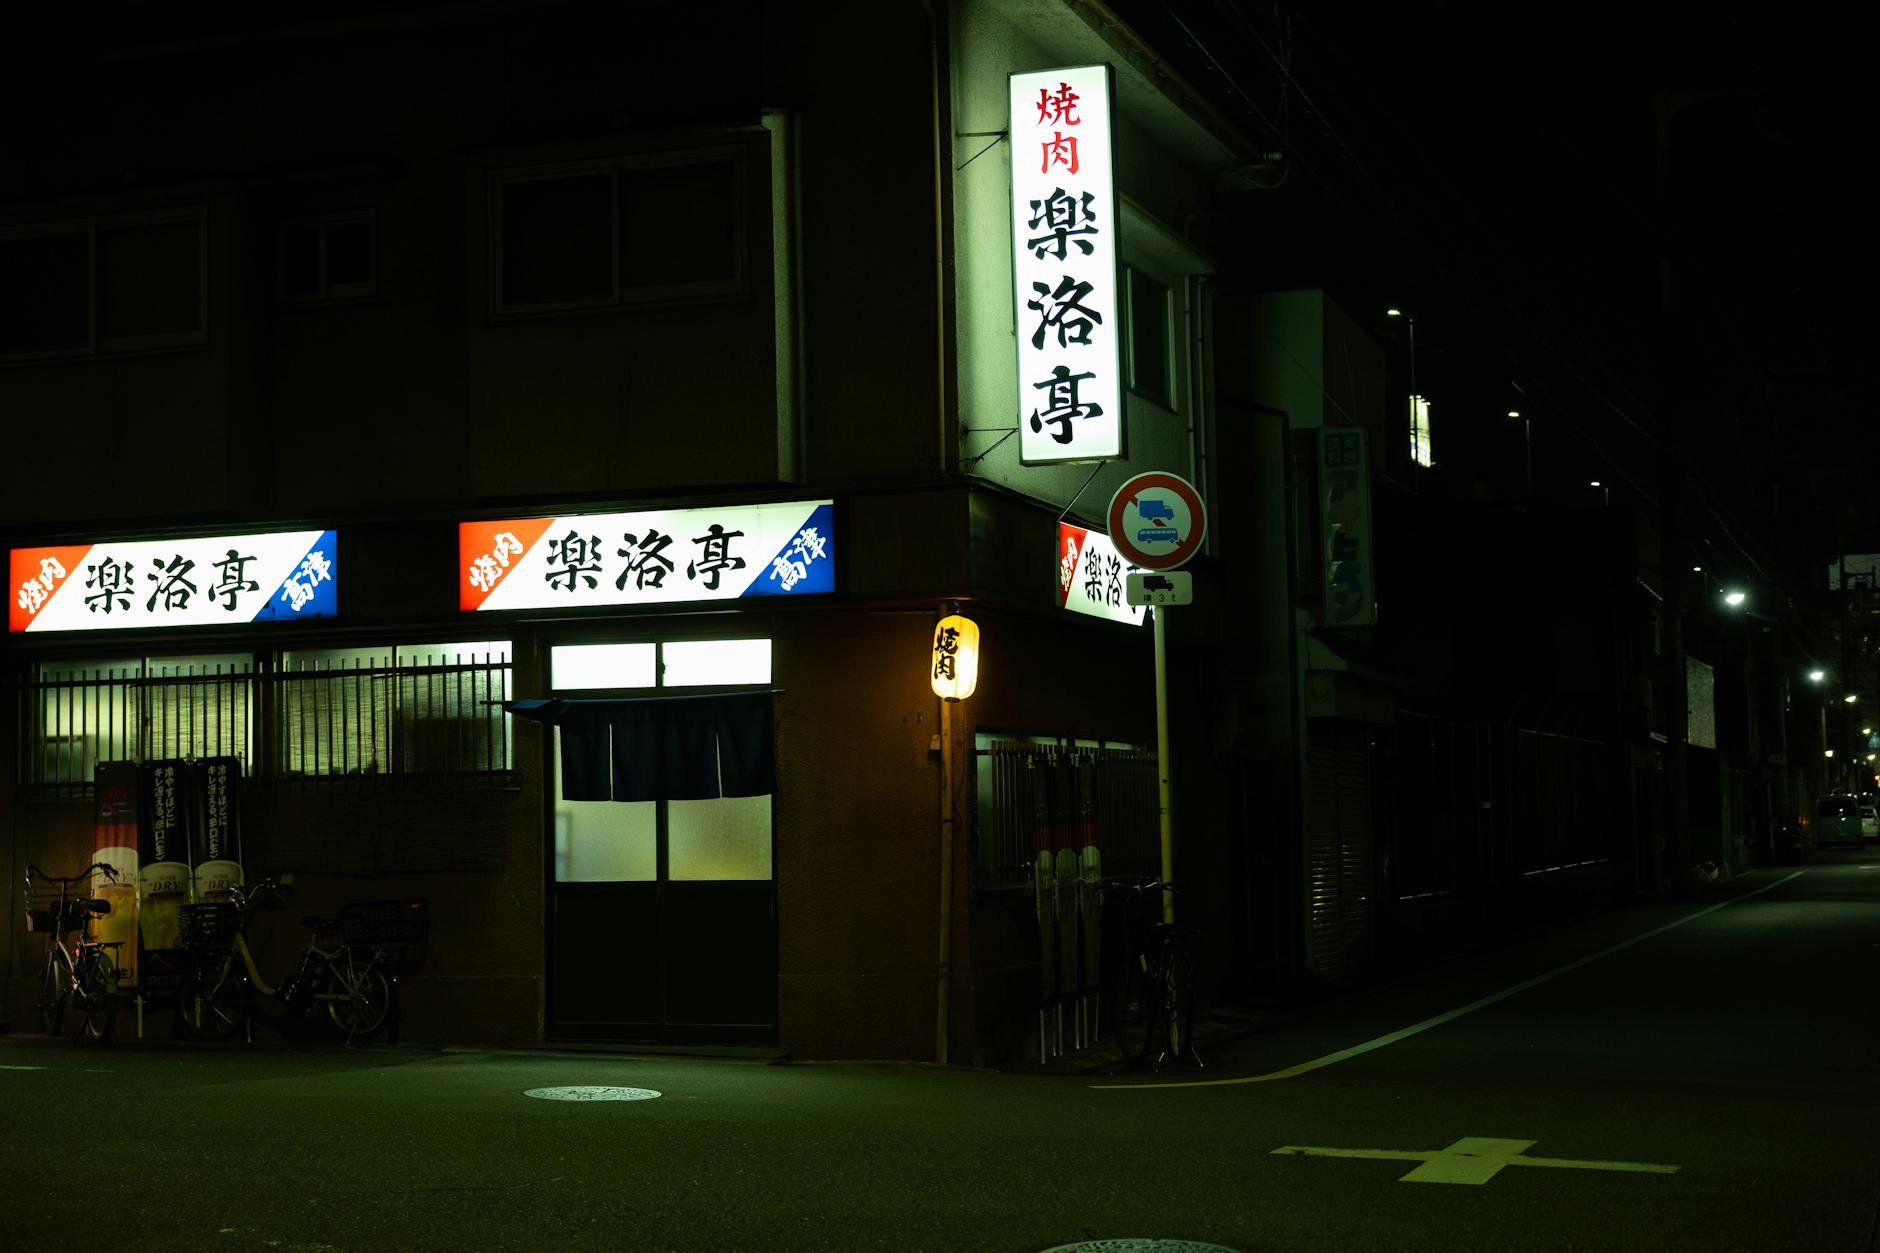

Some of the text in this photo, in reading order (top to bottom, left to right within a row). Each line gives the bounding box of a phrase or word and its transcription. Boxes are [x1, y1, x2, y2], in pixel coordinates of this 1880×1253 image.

[1036, 82, 1081, 175] 焼肉
[1027, 187, 1103, 444] 楽洛亭
[18, 557, 66, 614] 焼肉
[84, 549, 260, 614] 楽洛亭
[469, 532, 524, 592] 焼肉
[545, 524, 746, 592] 楽洛亭
[1061, 537, 1078, 592] 焼肉
[1085, 545, 1140, 615] 楽洛
[934, 627, 960, 680] 焼肉
